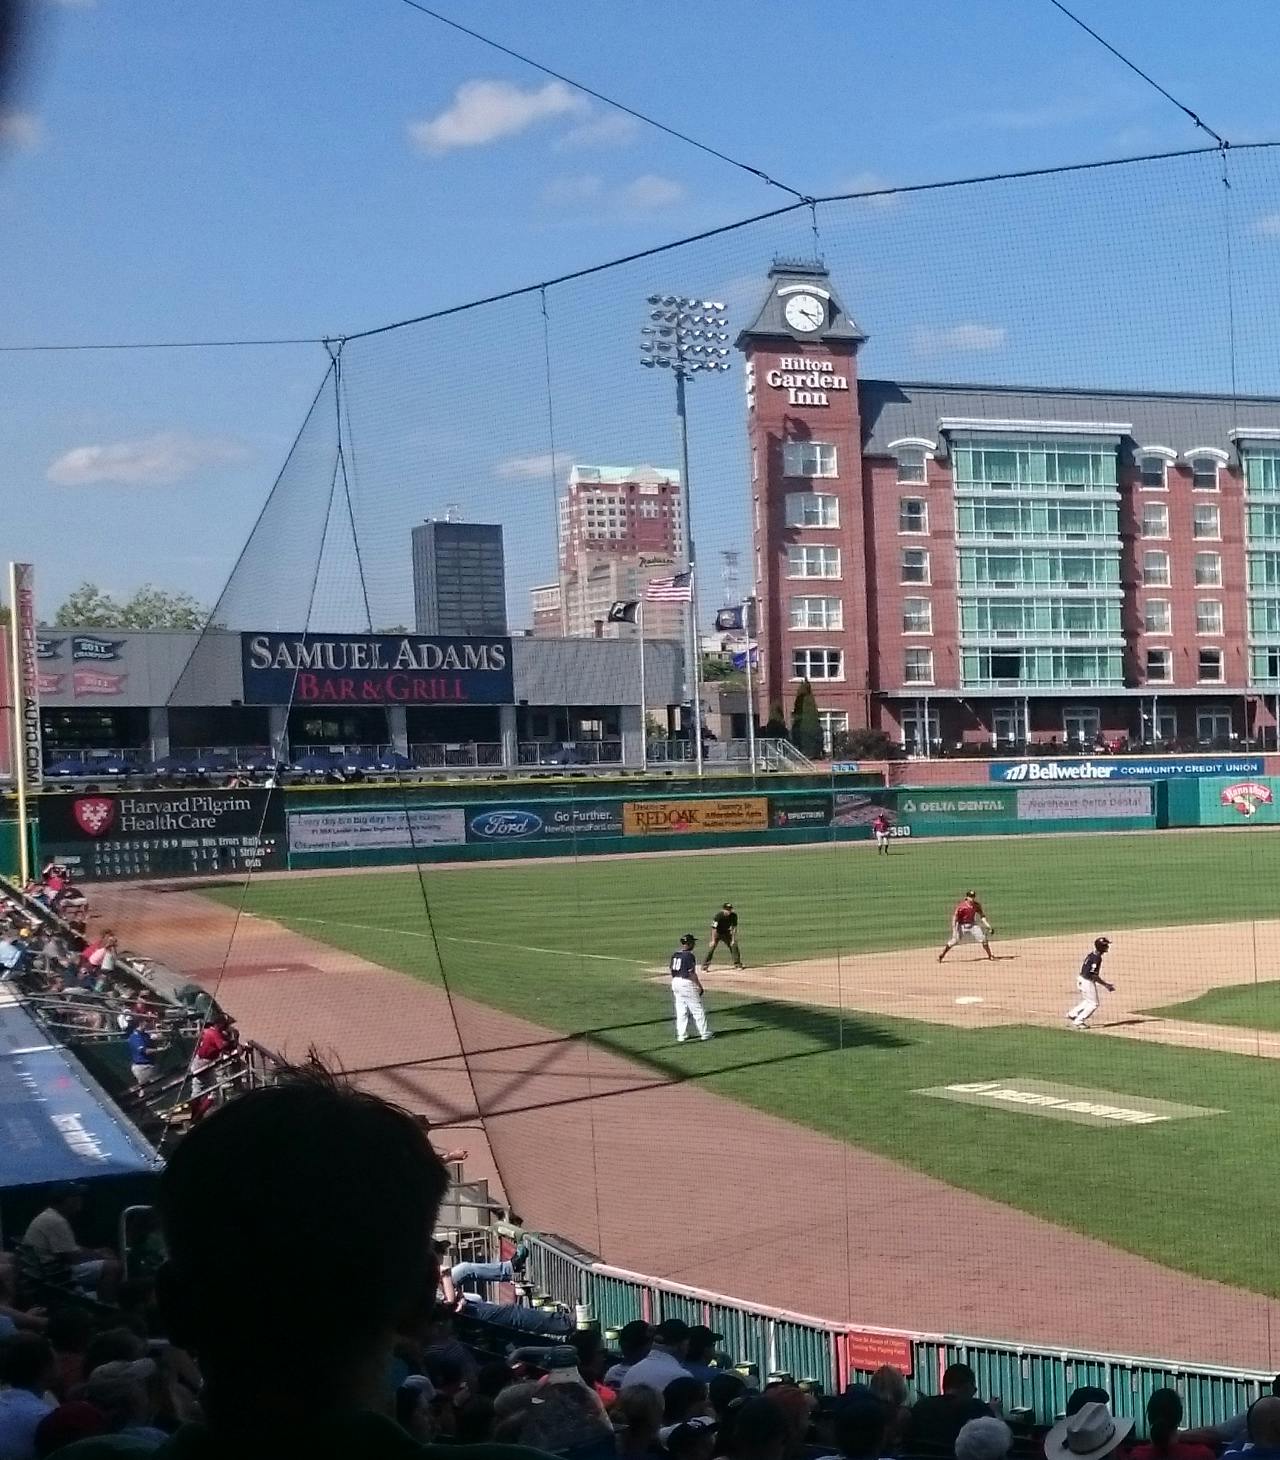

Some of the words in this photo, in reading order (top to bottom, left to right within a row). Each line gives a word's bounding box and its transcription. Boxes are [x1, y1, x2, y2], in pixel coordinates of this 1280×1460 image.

[780, 357, 833, 372] Hilton
[766, 370, 848, 389] Garden
[788, 388, 829, 406] Inn
[250, 637, 390, 670] SAMUEL
[393, 639, 506, 671] ADAMS
[300, 674, 355, 700] BAR
[363, 681, 380, 700] &
[385, 674, 469, 700] GRILL
[1029, 762, 1114, 780] Bellwether
[1120, 765, 1183, 775] COMMUNITY
[1185, 764, 1222, 774] CREDIT
[1225, 763, 1258, 772] UNION
[120, 798, 190, 815] Harvard
[192, 797, 251, 816] Pilgrim
[920, 801, 956, 812] DELTA
[957, 800, 1005, 811] DENTAL
[120, 816, 177, 831] Health
[178, 814, 217, 829] Care
[484, 814, 529, 835] Ford
[554, 811, 570, 822] Go
[573, 810, 613, 821] Further.
[633, 811, 667, 827] RED
[668, 809, 701, 824] OAK
[104, 842, 112, 851] 2
[113, 841, 121, 850] 3
[122, 841, 130, 850] 4
[133, 840, 140, 850] 5
[143, 839, 150, 849] 6
[153, 840, 160, 849] 7
[162, 839, 169, 848] 8
[171, 839, 178, 848] 9
[672, 957, 682, 971] 10
